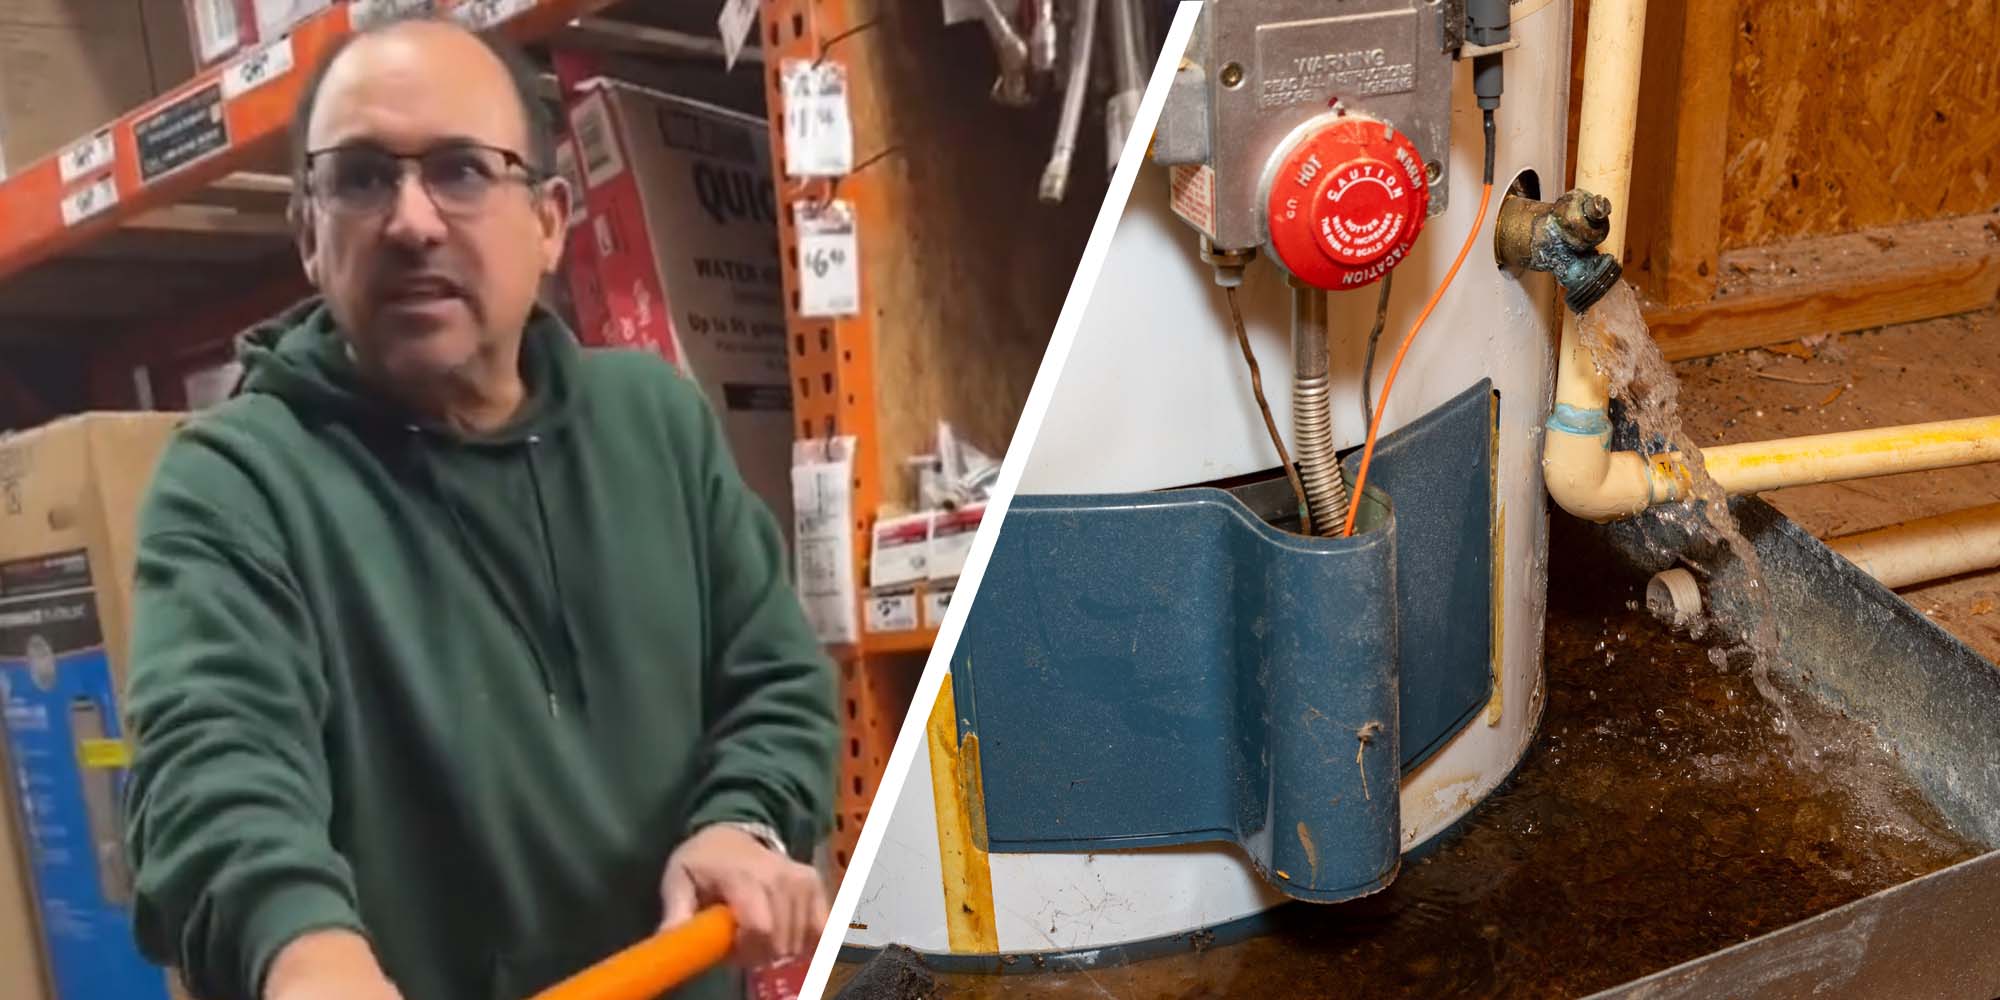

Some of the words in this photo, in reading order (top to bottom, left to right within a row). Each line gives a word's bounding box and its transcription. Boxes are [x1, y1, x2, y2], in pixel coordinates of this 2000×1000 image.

[1294, 47, 1385, 73] WARNING
[1301, 73, 1326, 89] ALL
[1358, 75, 1413, 94] LIGHTING
[1295, 154, 1323, 187] HOT
[1326, 165, 1404, 202] CAUTION
[1321, 215, 1332, 236] THE
[1332, 215, 1352, 243] WATER
[1353, 212, 1393, 245] INCREASES
[1344, 217, 1380, 234] HOTTER
[1383, 213, 1404, 244] INJURY
[1326, 233, 1343, 252] RISK
[1342, 247, 1355, 256] OF
[1355, 241, 1384, 258] SCALD
[693, 257, 757, 283] WATER
[1342, 242, 1409, 285] VACATION
